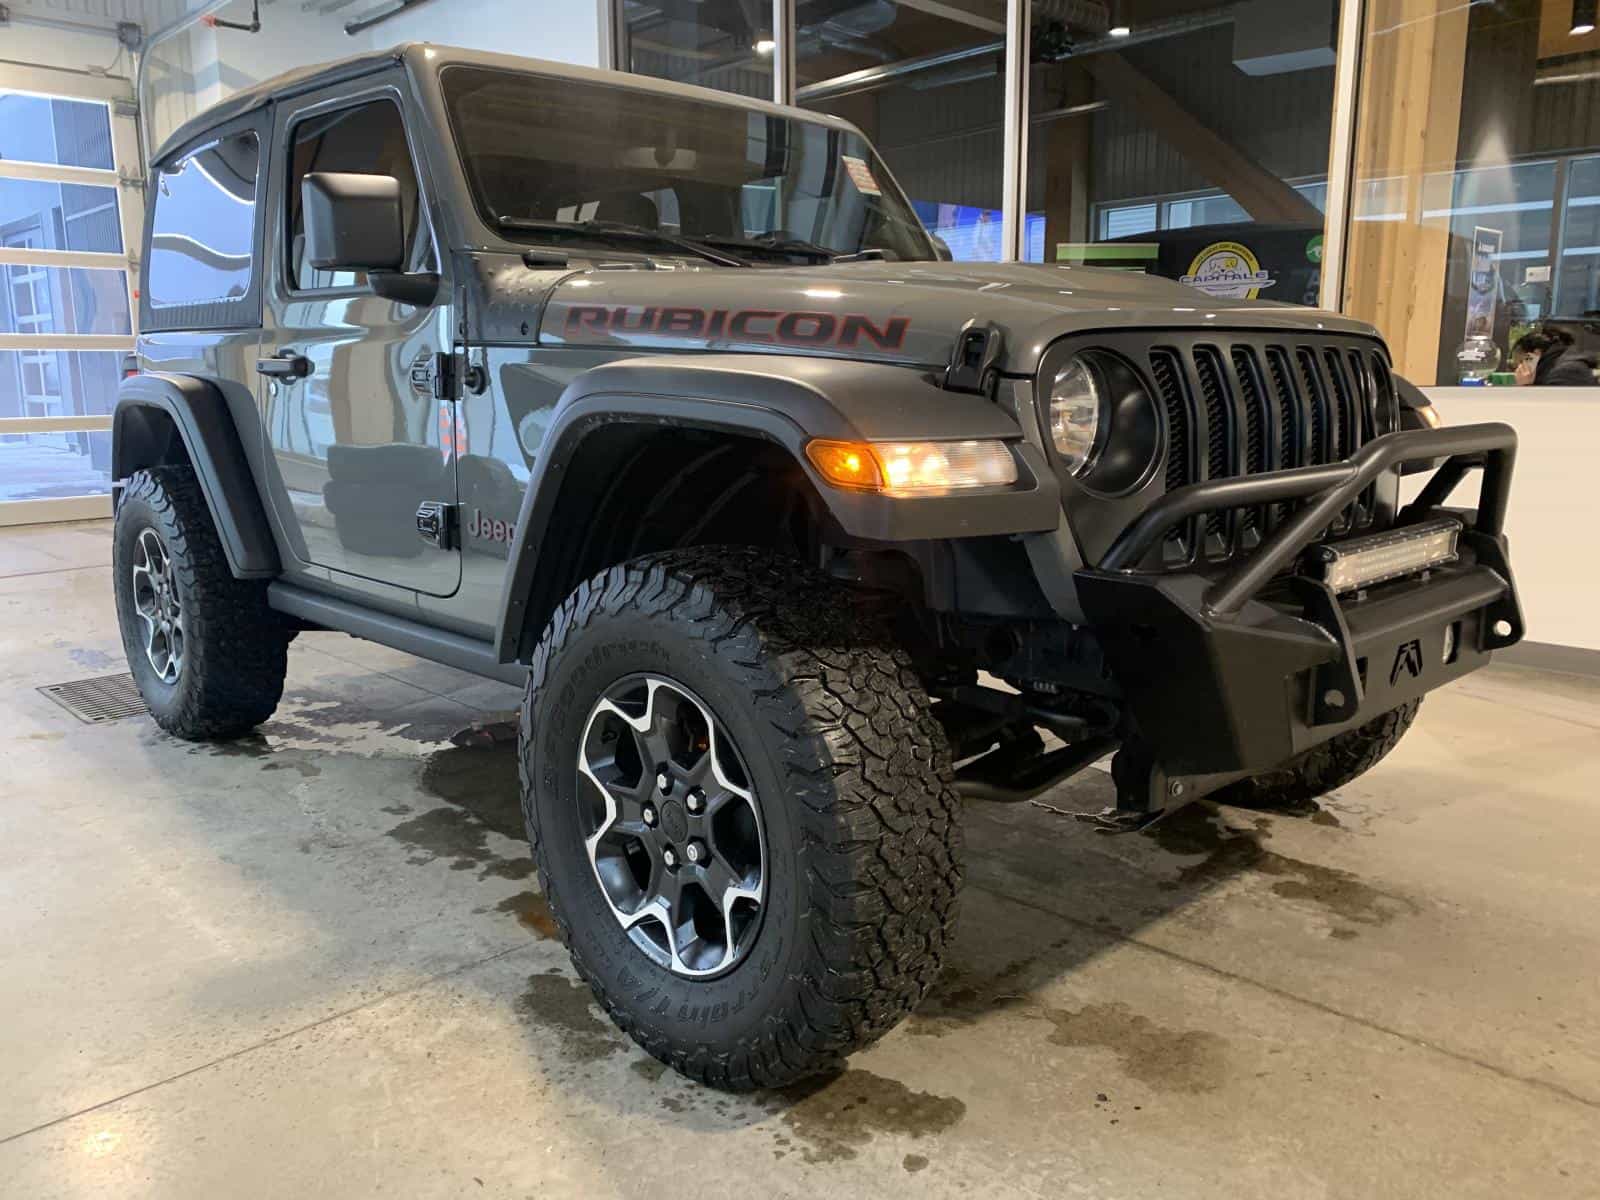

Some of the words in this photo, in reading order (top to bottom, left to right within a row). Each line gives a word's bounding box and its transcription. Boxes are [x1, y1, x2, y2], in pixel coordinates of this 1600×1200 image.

[1179, 270, 1267, 285] CAPITALE
[564, 305, 911, 349] RUBICON
[467, 508, 517, 549] Jeep
